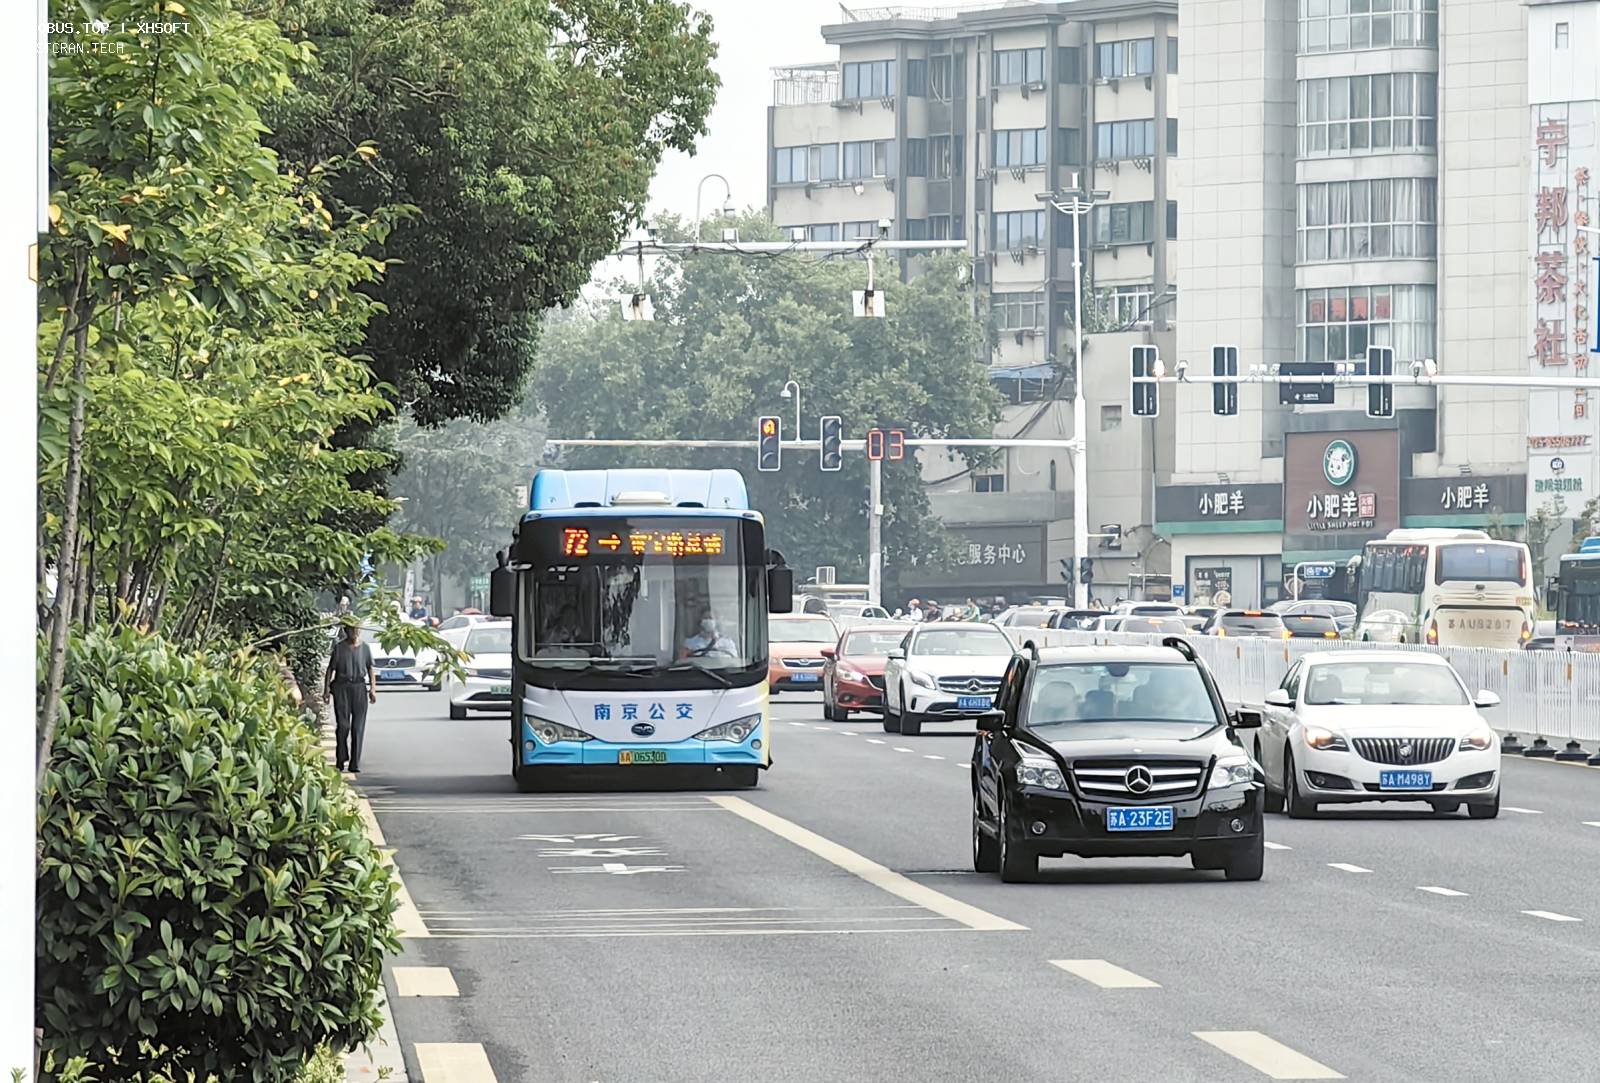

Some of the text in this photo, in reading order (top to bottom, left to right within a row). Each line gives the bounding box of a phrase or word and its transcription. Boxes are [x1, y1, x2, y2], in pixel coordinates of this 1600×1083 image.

[868, 430, 905, 461] 03
[1199, 490, 1245, 515] 小肥羊
[1306, 490, 1358, 519] 小肥羊
[1441, 483, 1490, 510] 小肥羊
[564, 529, 590, 555] 72
[593, 703, 694, 721] 南京公交
